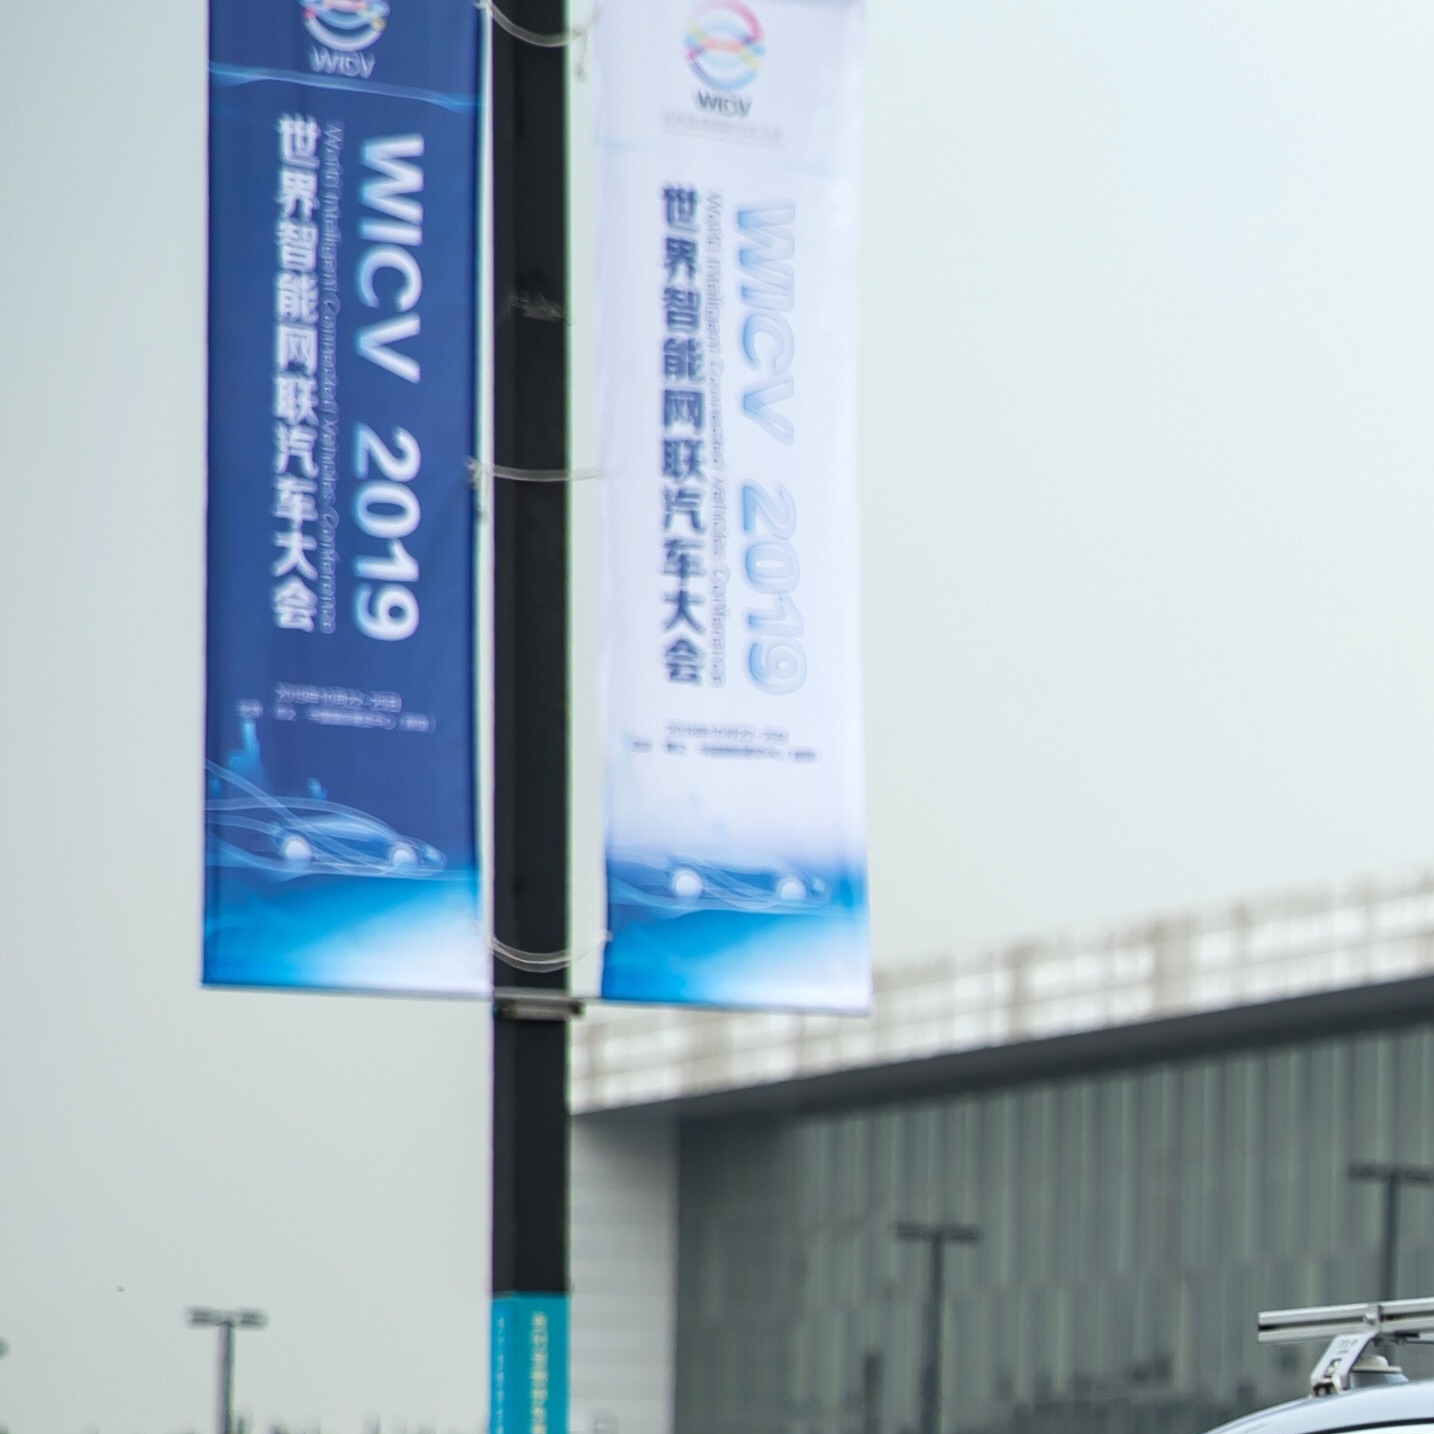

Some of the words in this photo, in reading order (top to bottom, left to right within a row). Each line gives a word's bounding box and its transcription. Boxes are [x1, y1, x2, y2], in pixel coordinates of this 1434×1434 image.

[273, 114, 320, 635] 世界智能网联汽车大会
[356, 133, 425, 384] WICV
[736, 198, 798, 447] WICV
[353, 423, 421, 642] 2019
[659, 185, 706, 687] 世界智能网联汽车大会
[738, 482, 808, 696] 2019
